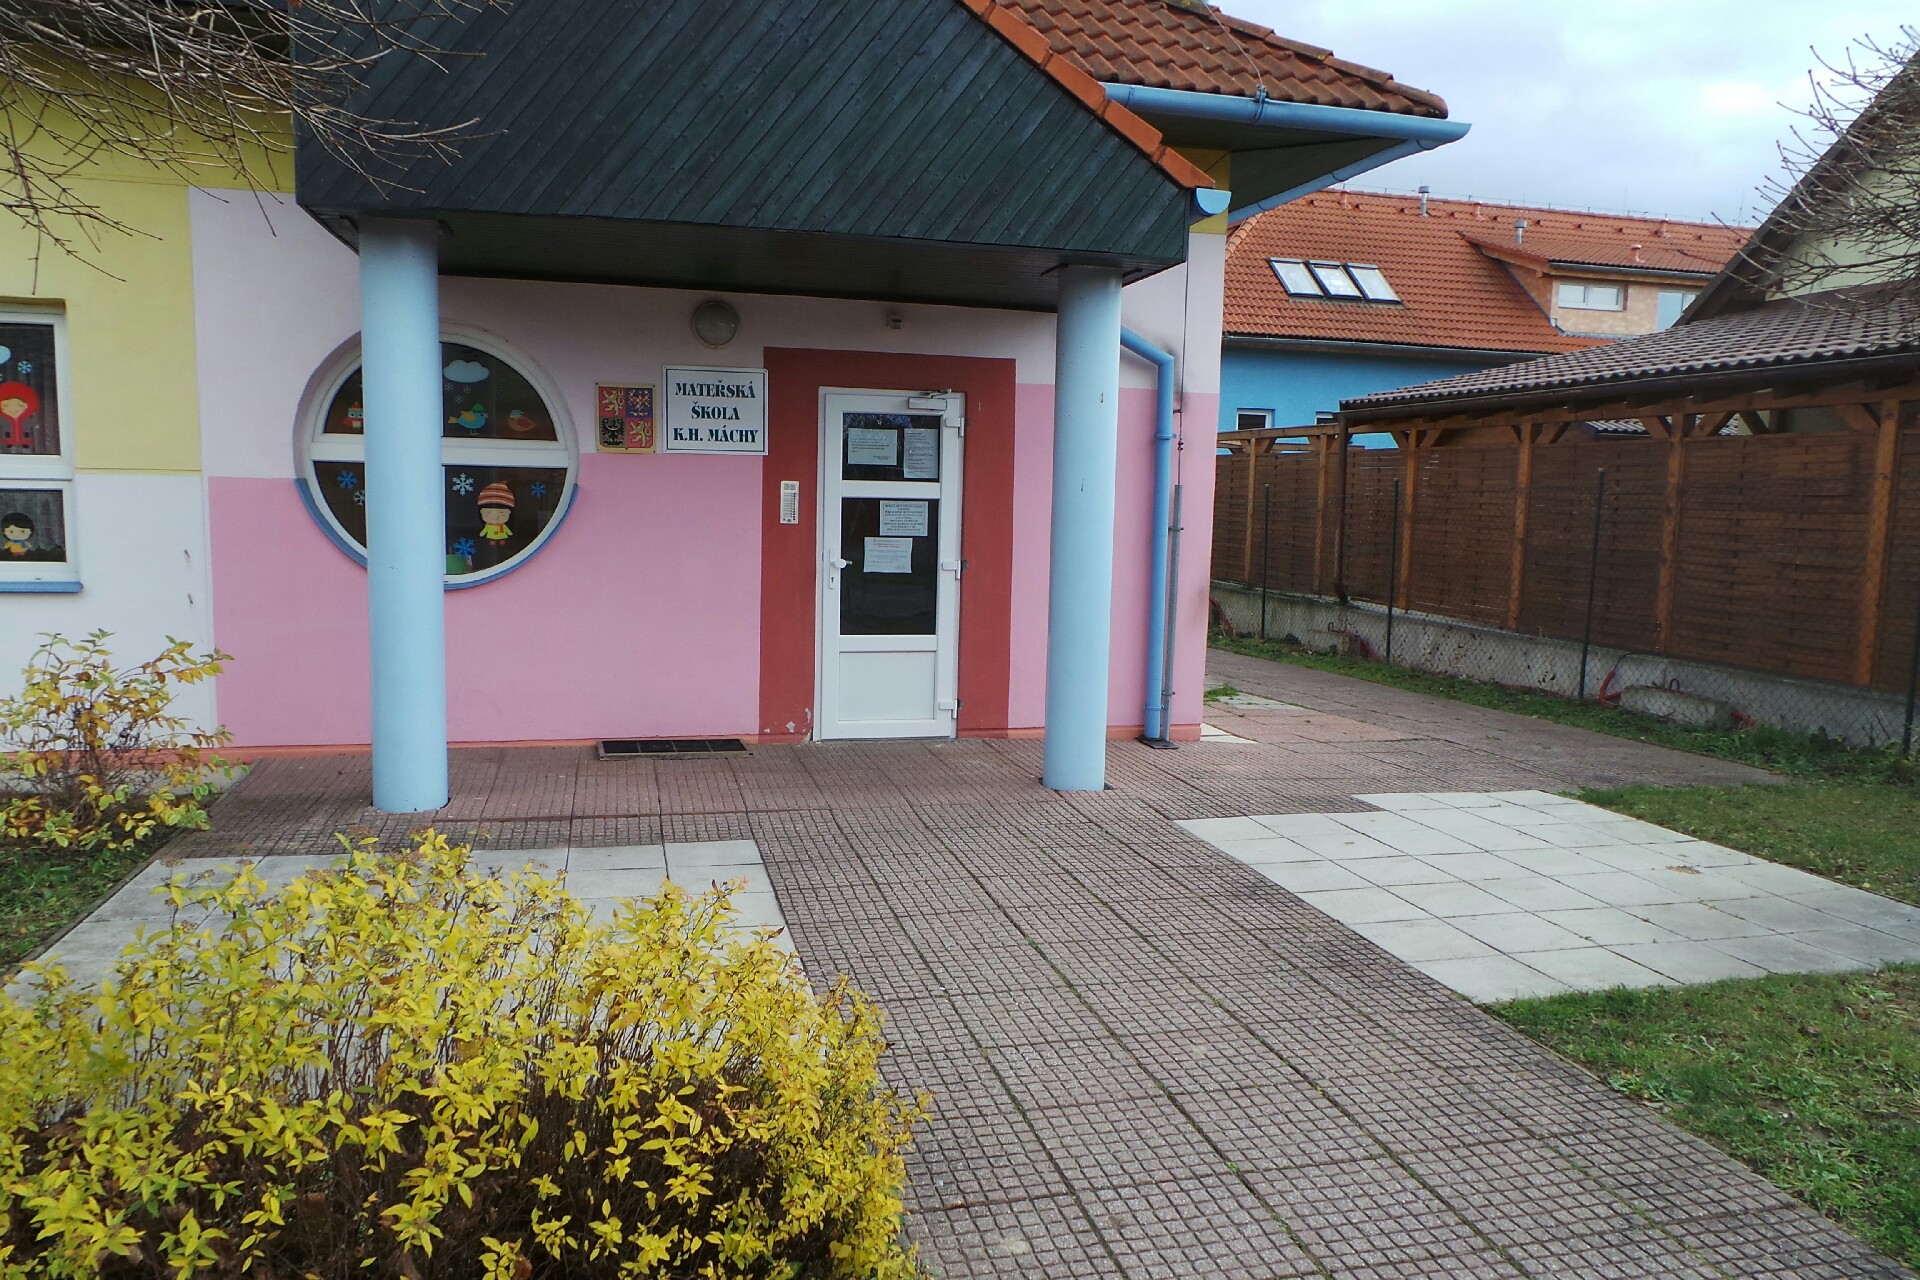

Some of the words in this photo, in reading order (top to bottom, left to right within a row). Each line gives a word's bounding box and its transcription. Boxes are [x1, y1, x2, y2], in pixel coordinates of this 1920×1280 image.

[675, 379, 756, 399] MATEŘSKÁ
[691, 400, 741, 421] ŠKOLA
[673, 427, 704, 442] K.H.
[708, 424, 759, 444] MÁCHY
